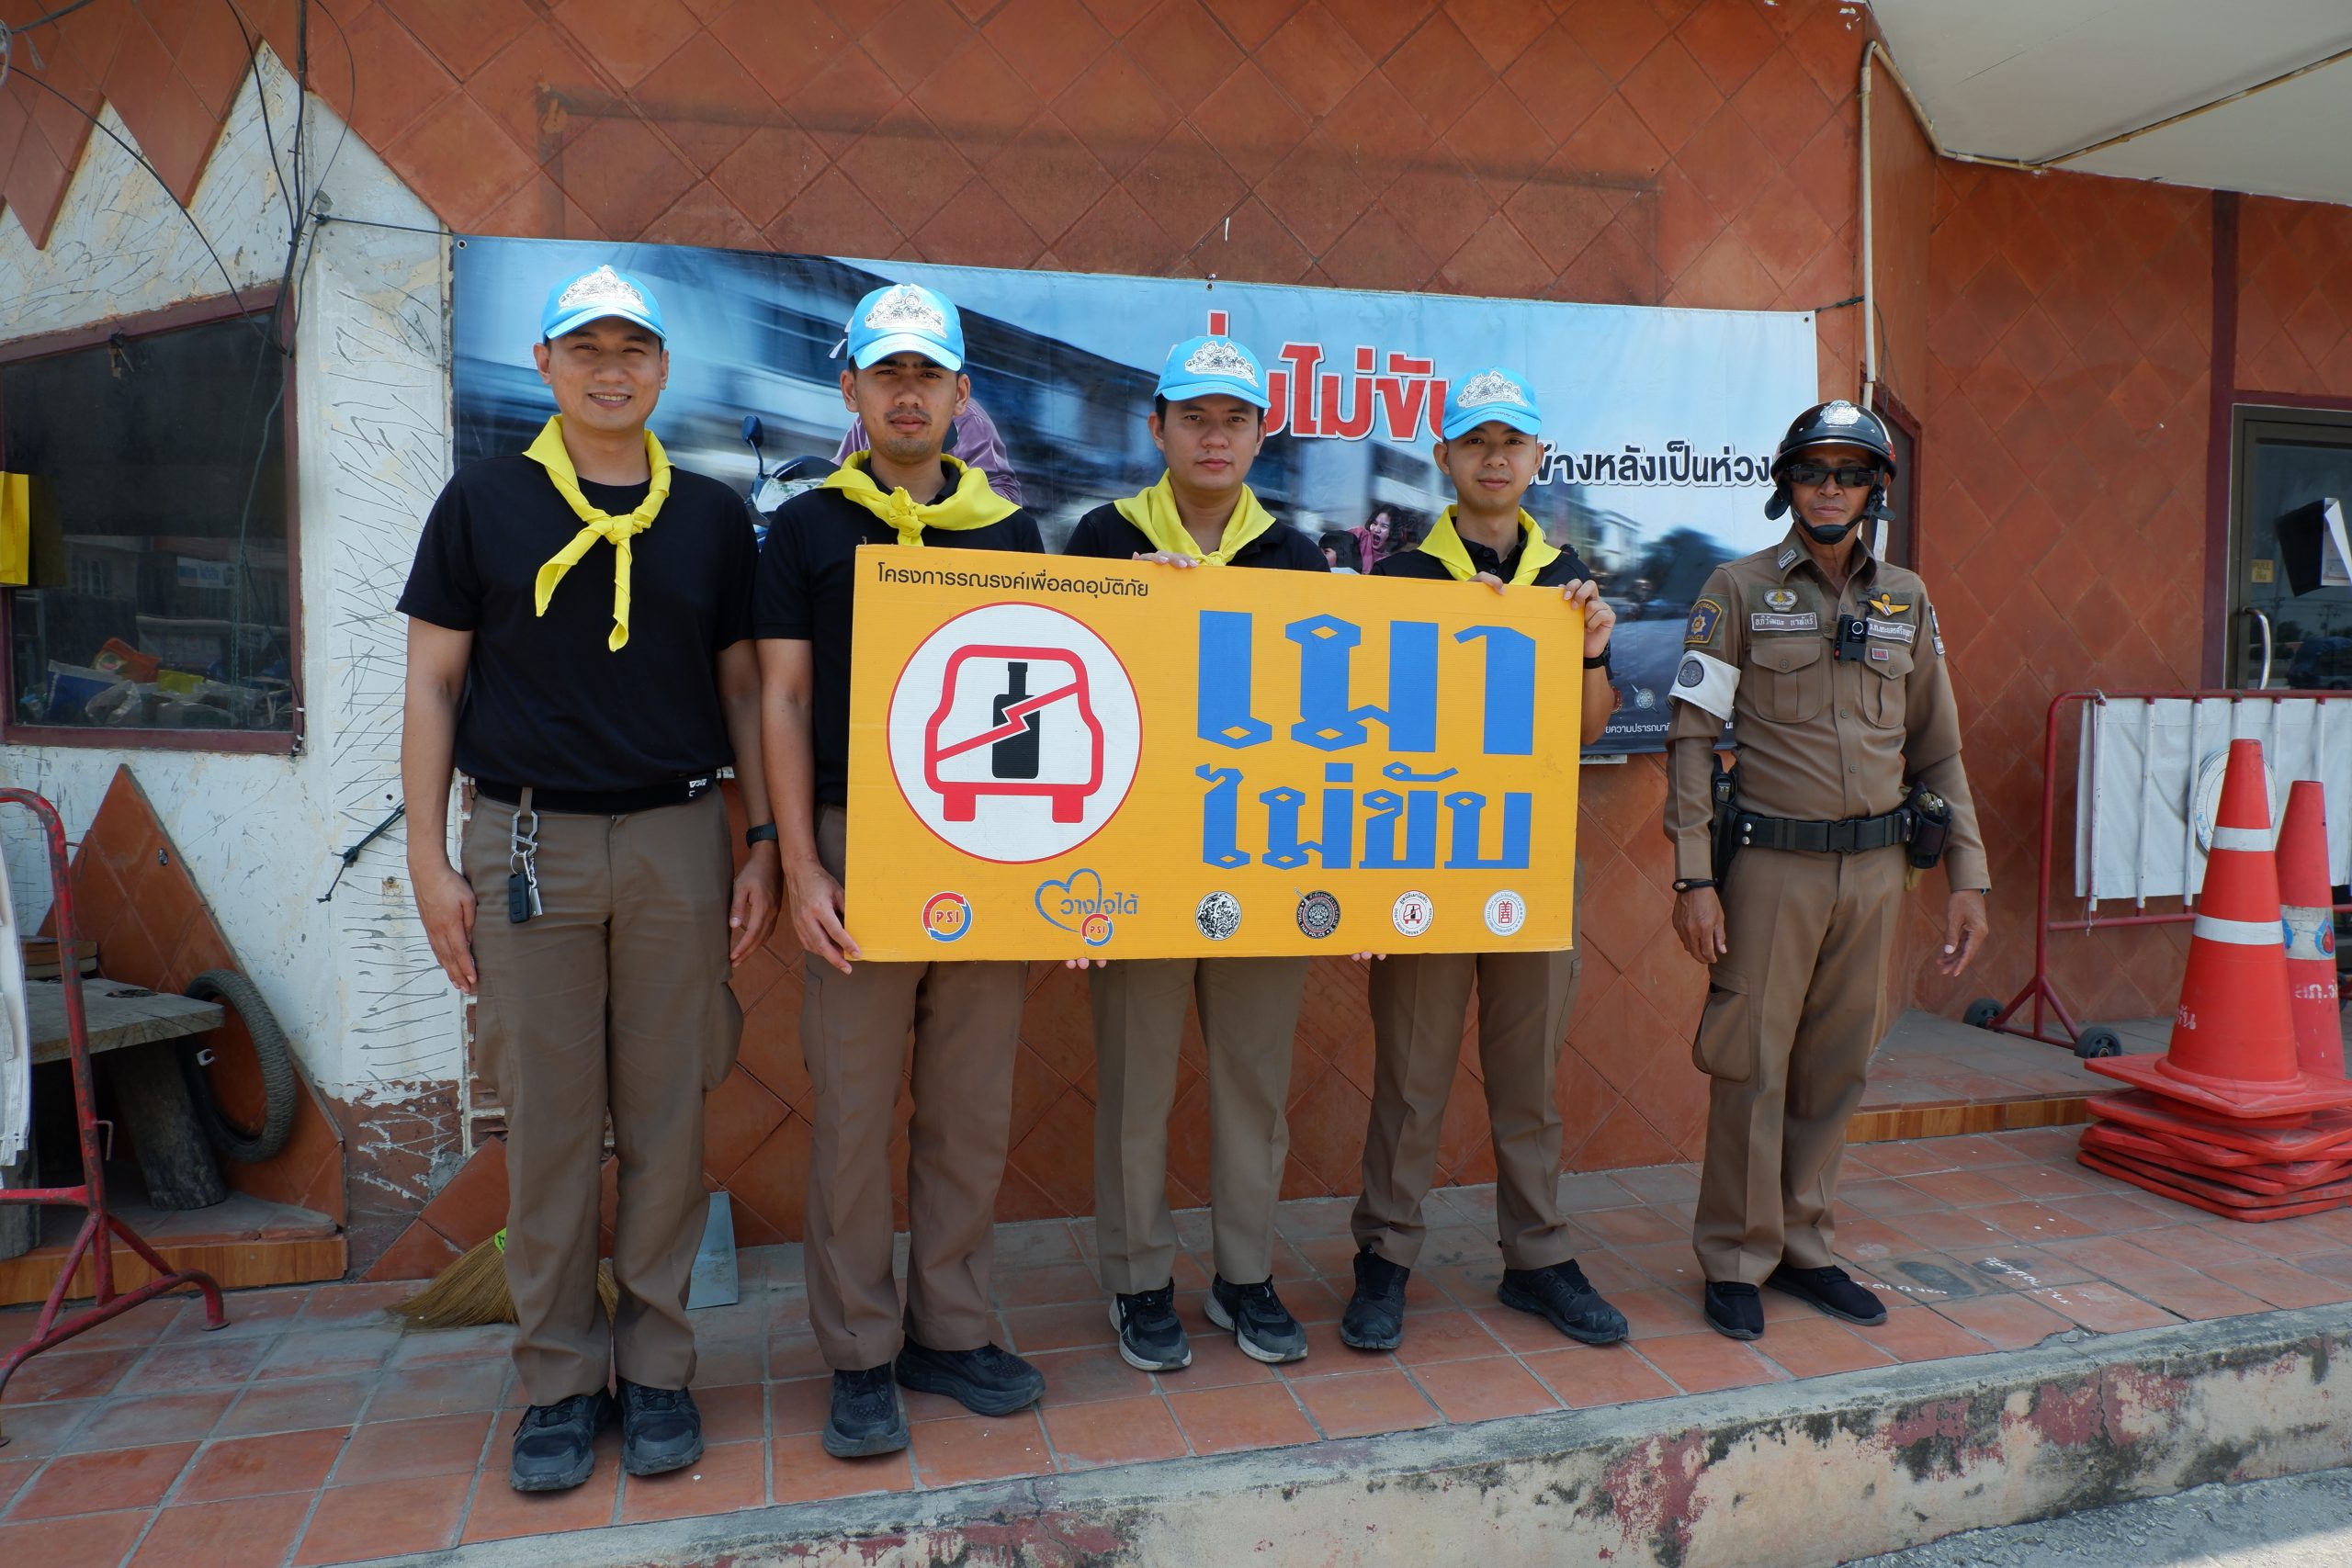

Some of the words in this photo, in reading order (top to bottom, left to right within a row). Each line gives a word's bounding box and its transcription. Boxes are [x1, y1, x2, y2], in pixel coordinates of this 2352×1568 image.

[1197, 609, 1536, 756] เมา
[1195, 761, 1532, 871] ไม่ขับ
[935, 910, 960, 924] PSI
[1090, 925, 1106, 935] PSI
